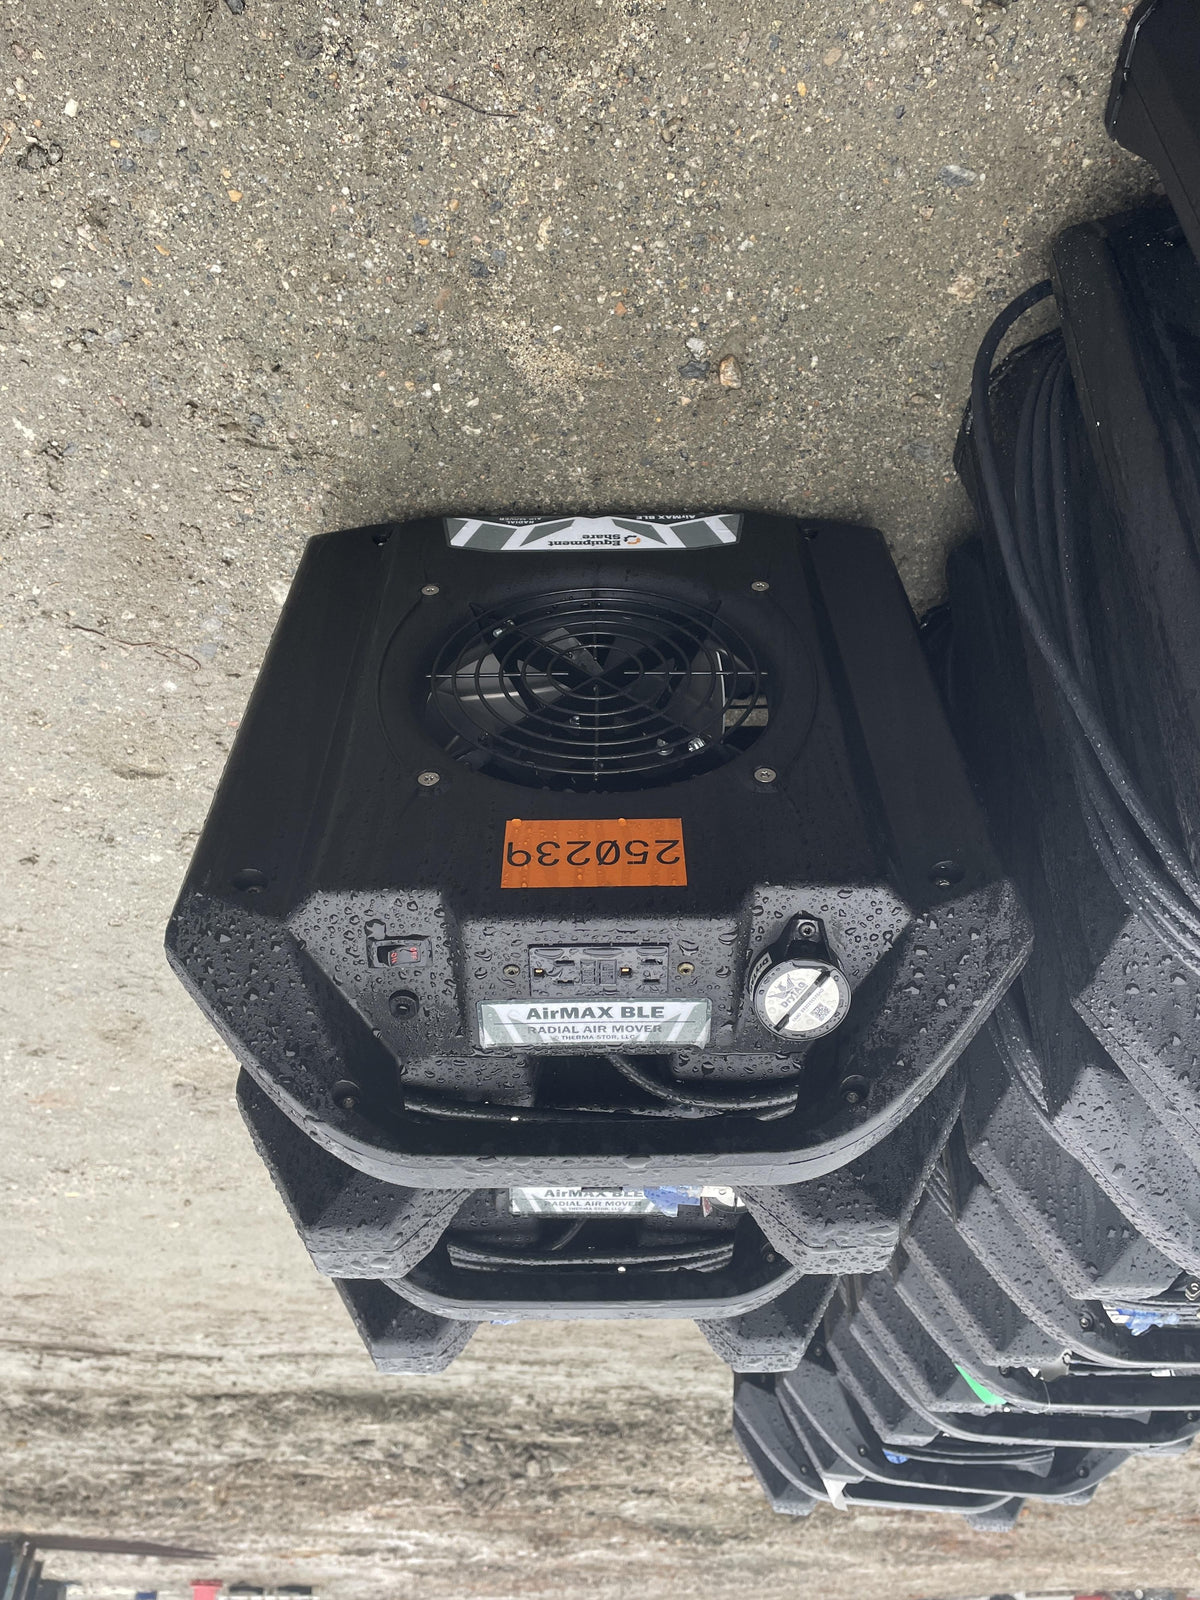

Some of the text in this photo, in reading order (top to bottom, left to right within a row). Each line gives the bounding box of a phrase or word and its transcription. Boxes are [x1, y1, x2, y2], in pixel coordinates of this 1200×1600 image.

[548, 538, 621, 548] Equipment
[391, 952, 397, 964] ON
[780, 981, 806, 1008] DryTAG
[526, 1006, 665, 1020] AirMAX BLE
[527, 1024, 662, 1035] RADIAL AIR MOVER
[544, 1189, 644, 1198] AirMAX BLE
